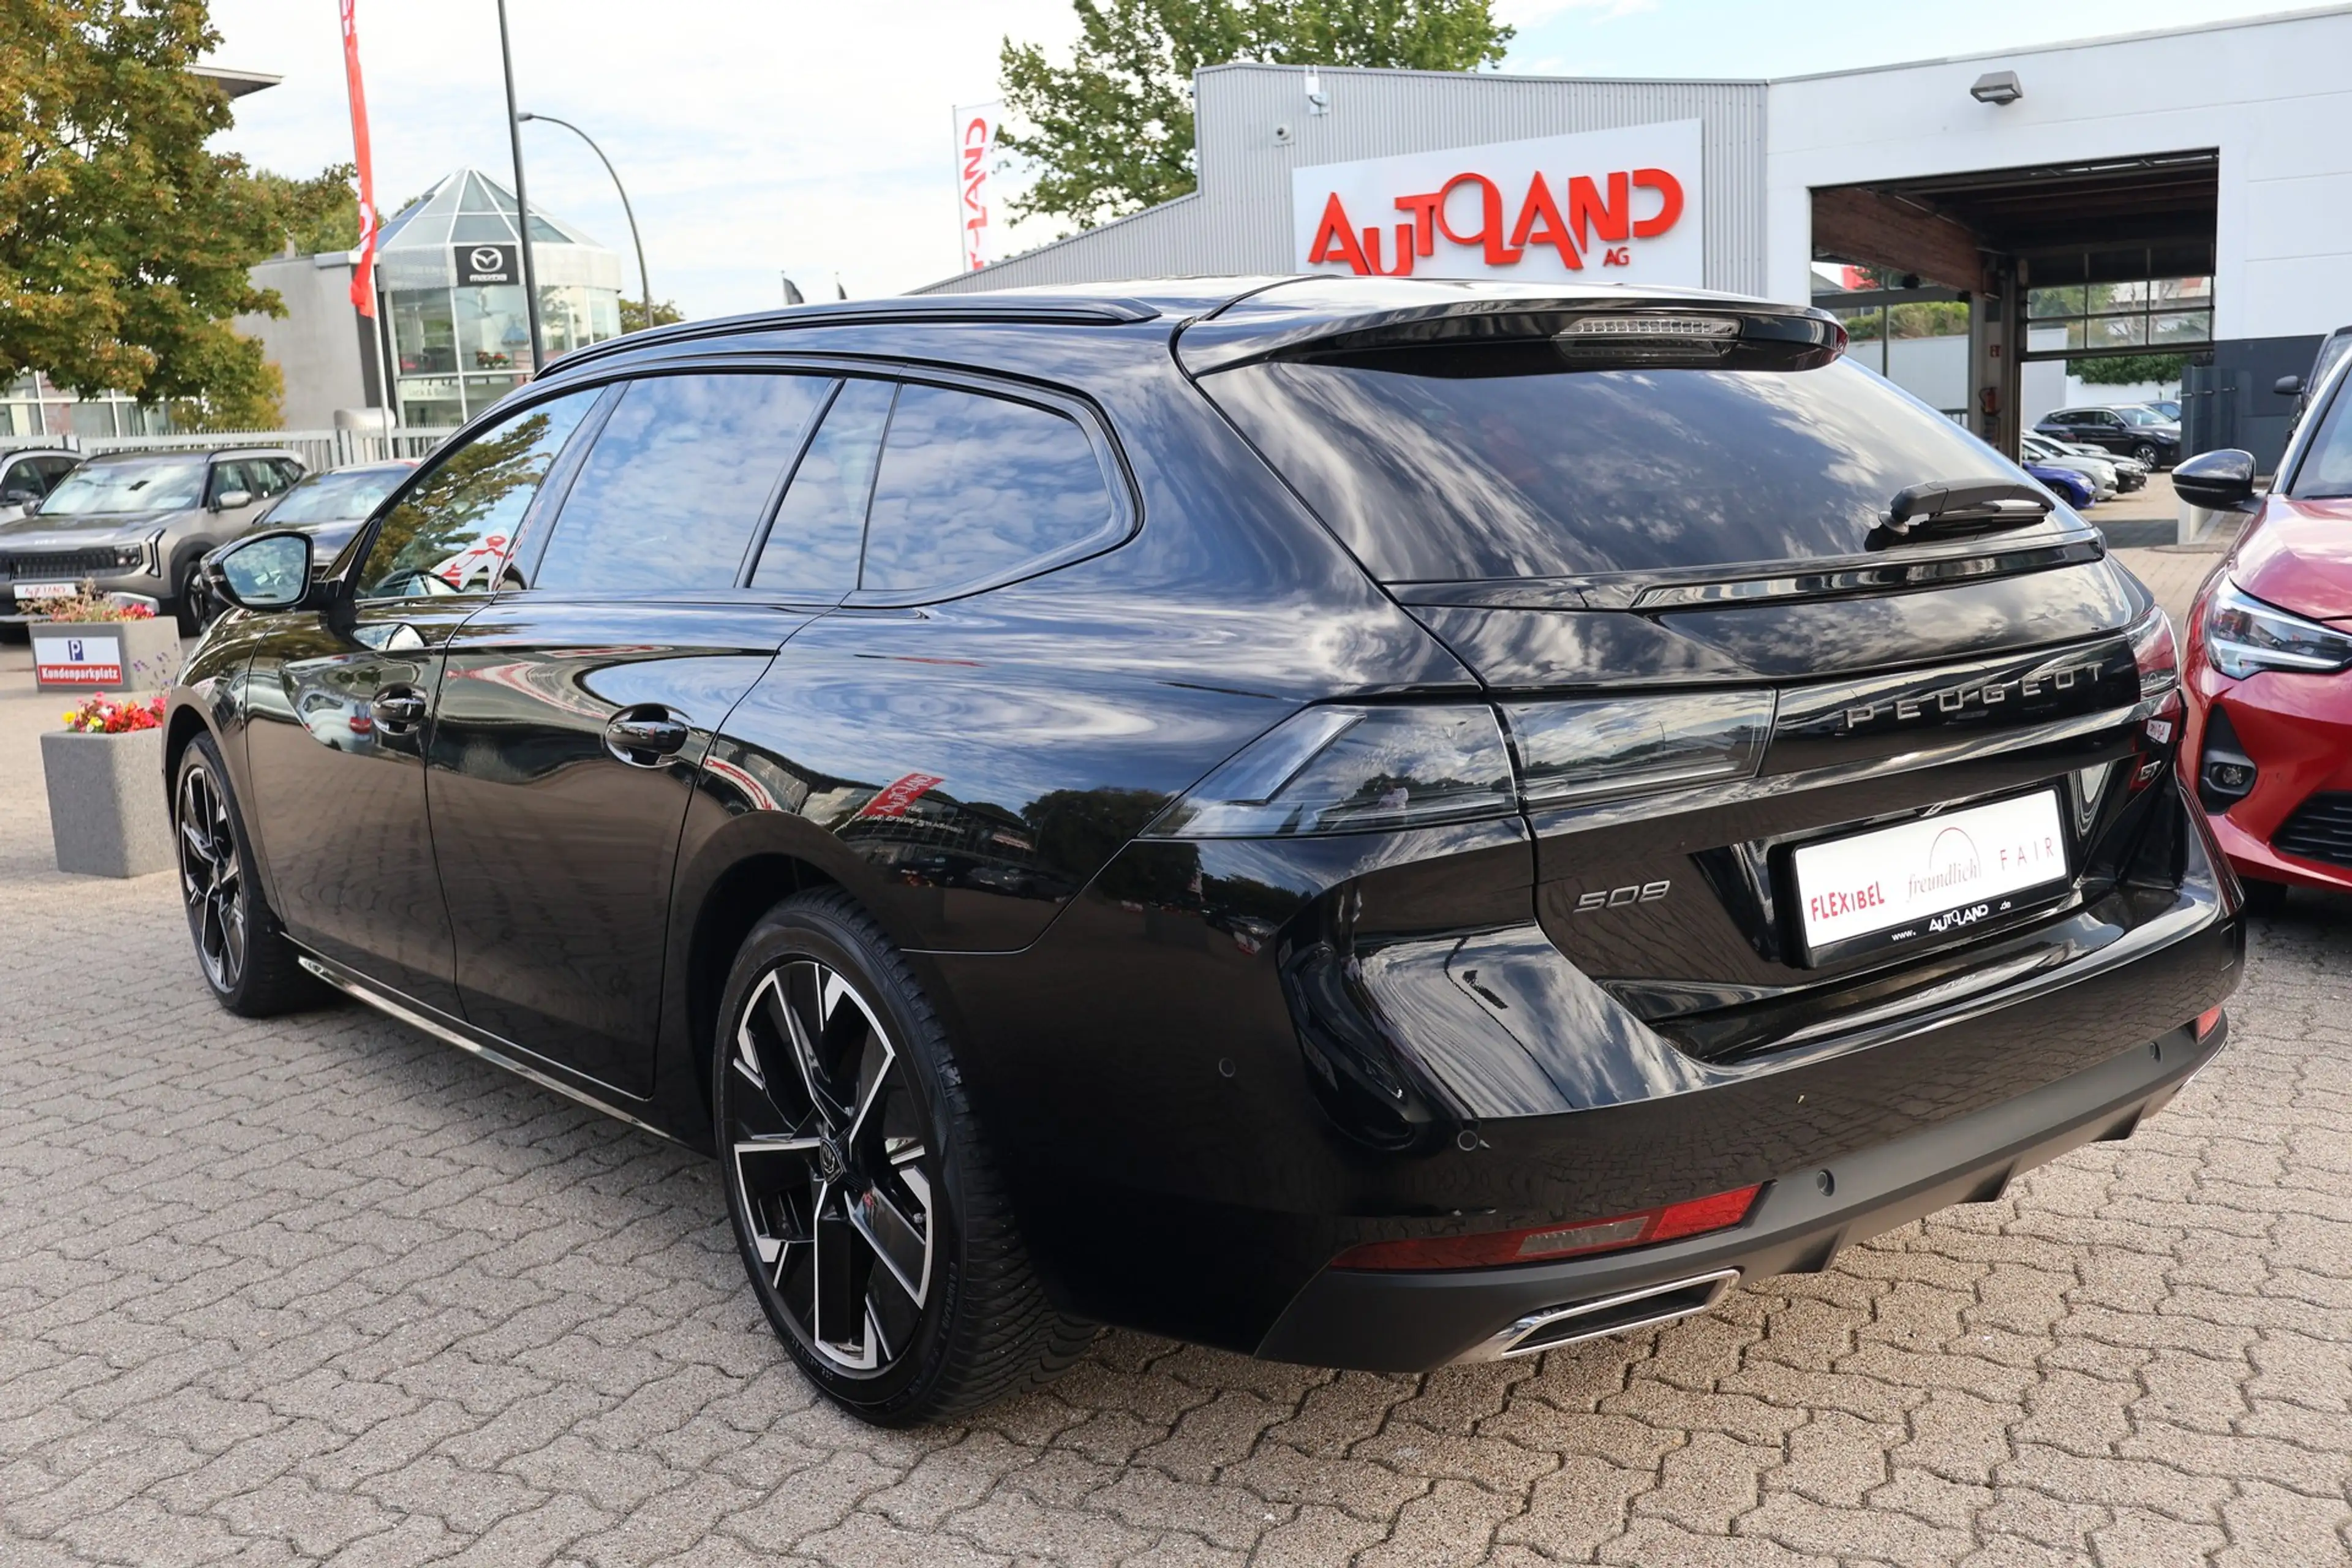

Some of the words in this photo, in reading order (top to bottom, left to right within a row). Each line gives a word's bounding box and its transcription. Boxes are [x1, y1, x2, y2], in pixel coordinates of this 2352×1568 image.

[1308, 168, 1684, 276] AUTOLAND
[1603, 247, 1630, 267] AG
[70, 641, 81, 661] P
[42, 668, 119, 681] Kundenparkplatz
[1847, 662, 2103, 728] PEUGEOT
[2138, 760, 2161, 782] GT
[1811, 881, 1885, 921] FLEXIBEL
[1905, 859, 1978, 903] freundlich
[2000, 837, 2054, 871] FAIR
[1573, 880, 1670, 914] 508
[1891, 929, 1917, 941] www.
[1928, 903, 1989, 933] AUTOLAND
[1999, 900, 2011, 911] .de
